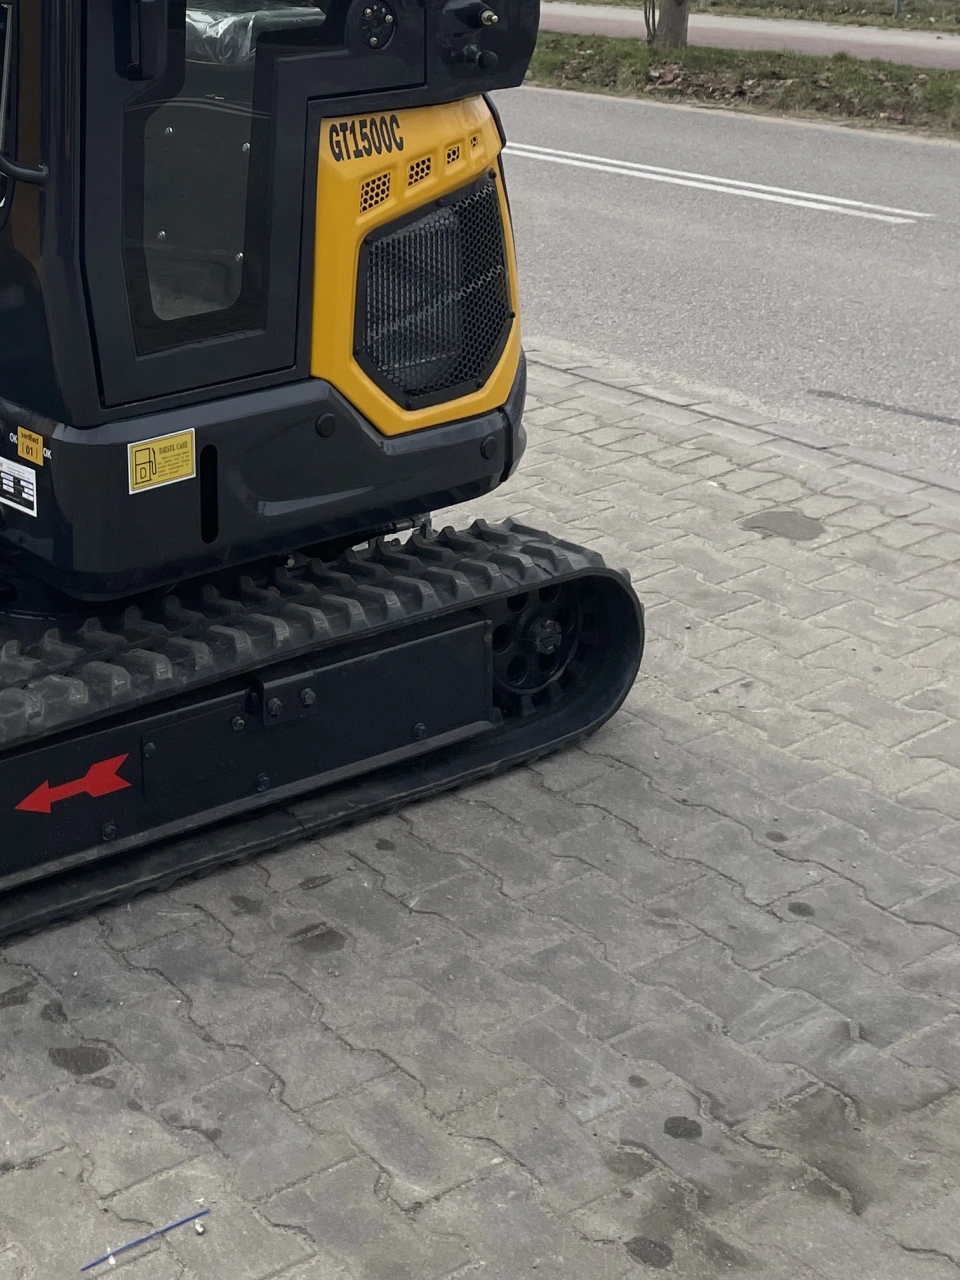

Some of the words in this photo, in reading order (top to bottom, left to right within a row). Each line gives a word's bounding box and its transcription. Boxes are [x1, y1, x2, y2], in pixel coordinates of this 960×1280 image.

[329, 114, 404, 162] GT1500C
[43, 448, 52, 459] OK
[159, 444, 176, 455] DIESEL
